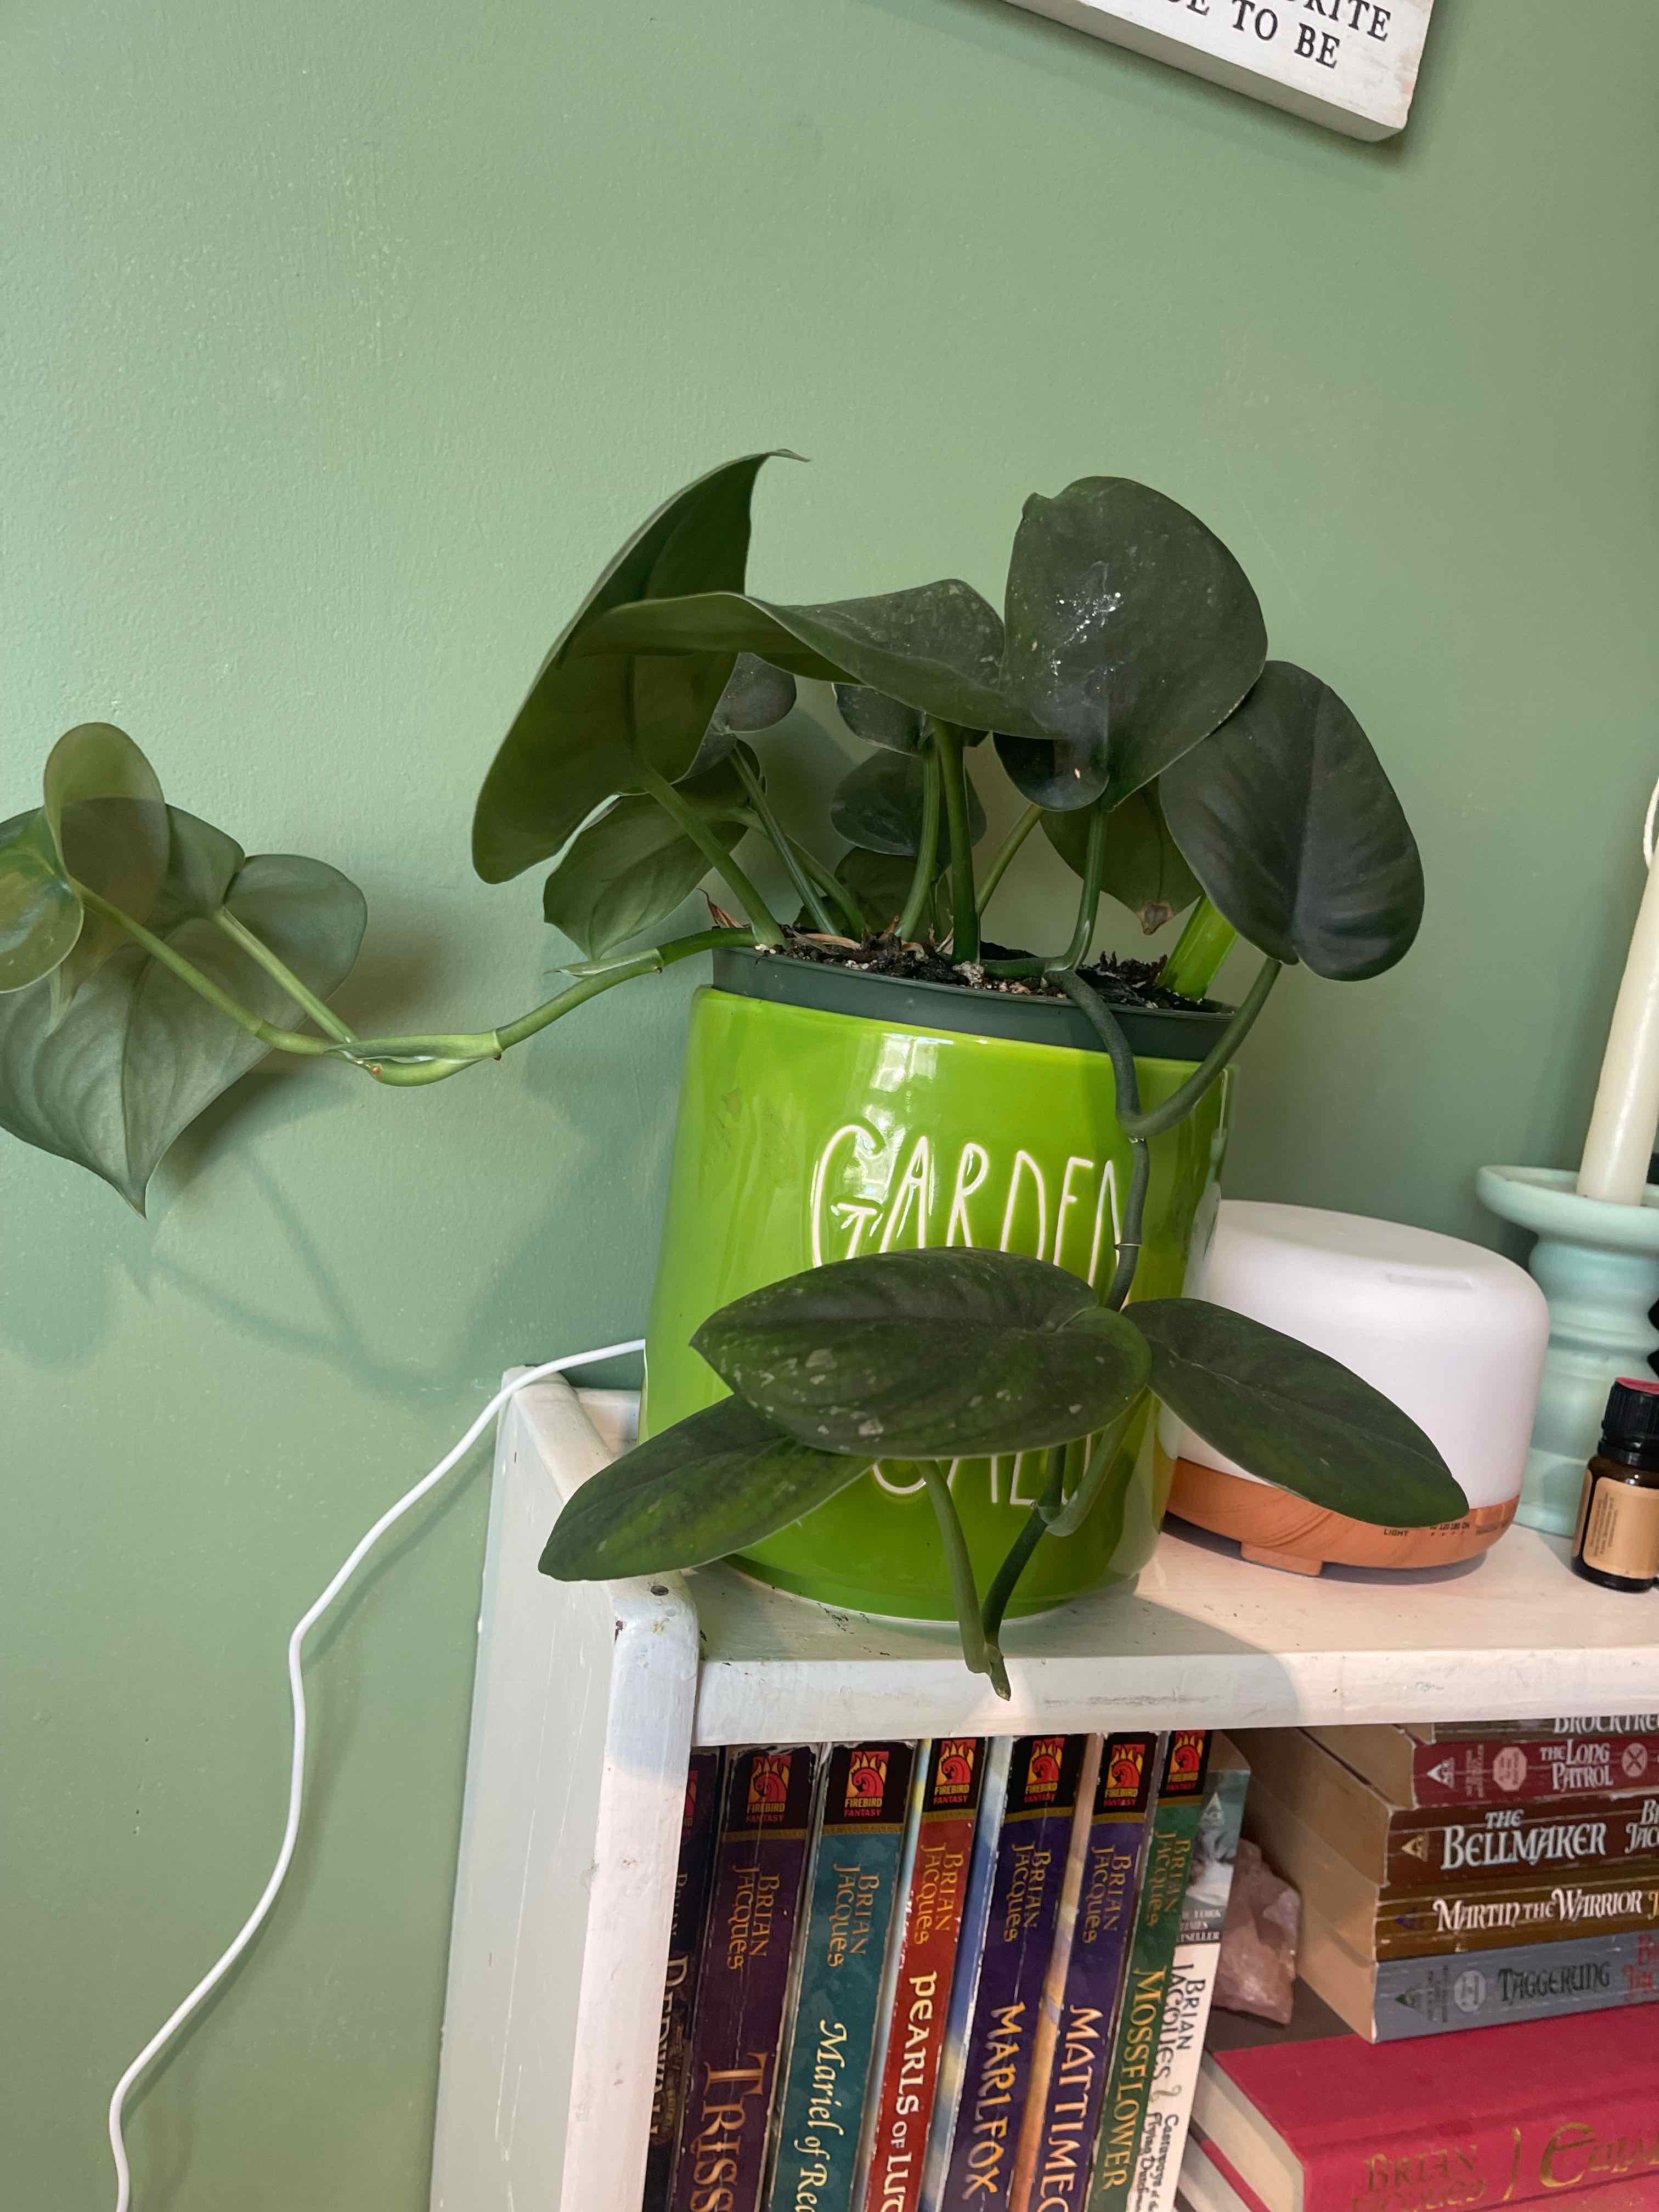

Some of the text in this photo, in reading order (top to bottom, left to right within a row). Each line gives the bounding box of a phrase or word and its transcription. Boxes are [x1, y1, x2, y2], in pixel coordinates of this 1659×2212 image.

[1232, 0, 1340, 69] TO BE
[1286, 0, 1391, 42] RITE
[1554, 1714, 1659, 1734] BROCKTRE
[1540, 1739, 1611, 1765] THE LONG
[934, 1784, 969, 1795] FIREBIRD
[1552, 1762, 1613, 1792] PATROL
[746, 1814, 784, 1823] FANTASY
[747, 1803, 785, 1814] FIREBIRD
[844, 1808, 882, 1818] FANTASY
[845, 1798, 882, 1808] FIREBIRD
[934, 1795, 968, 1805] FANTASY
[1485, 1809, 1524, 1829] THE
[1440, 1822, 1607, 1870] BELLMAKER
[935, 1851, 964, 1931] BRIAN
[1024, 1849, 1052, 1928] BRIAN
[1103, 1854, 1133, 1931] BRIAN
[1165, 1839, 1191, 1913] BRIAN
[749, 1874, 780, 1957] BRIAN
[849, 1873, 880, 1954] BRIAN
[1432, 1897, 1520, 1932] MARTIN
[1522, 1900, 1556, 1919] THE
[1551, 1887, 1643, 1921] WARRIOR
[1499, 1961, 1611, 2005] TAGGERUNG
[1176, 1979, 1206, 2050] BRIAN
[807, 2019, 848, 2136] Mariel
[1103, 1966, 1167, 2191] MOSSFLOWER
[962, 2001, 1026, 2200] MARLFOX
[793, 2136, 831, 2162] of
[891, 2121, 907, 2148] OF
